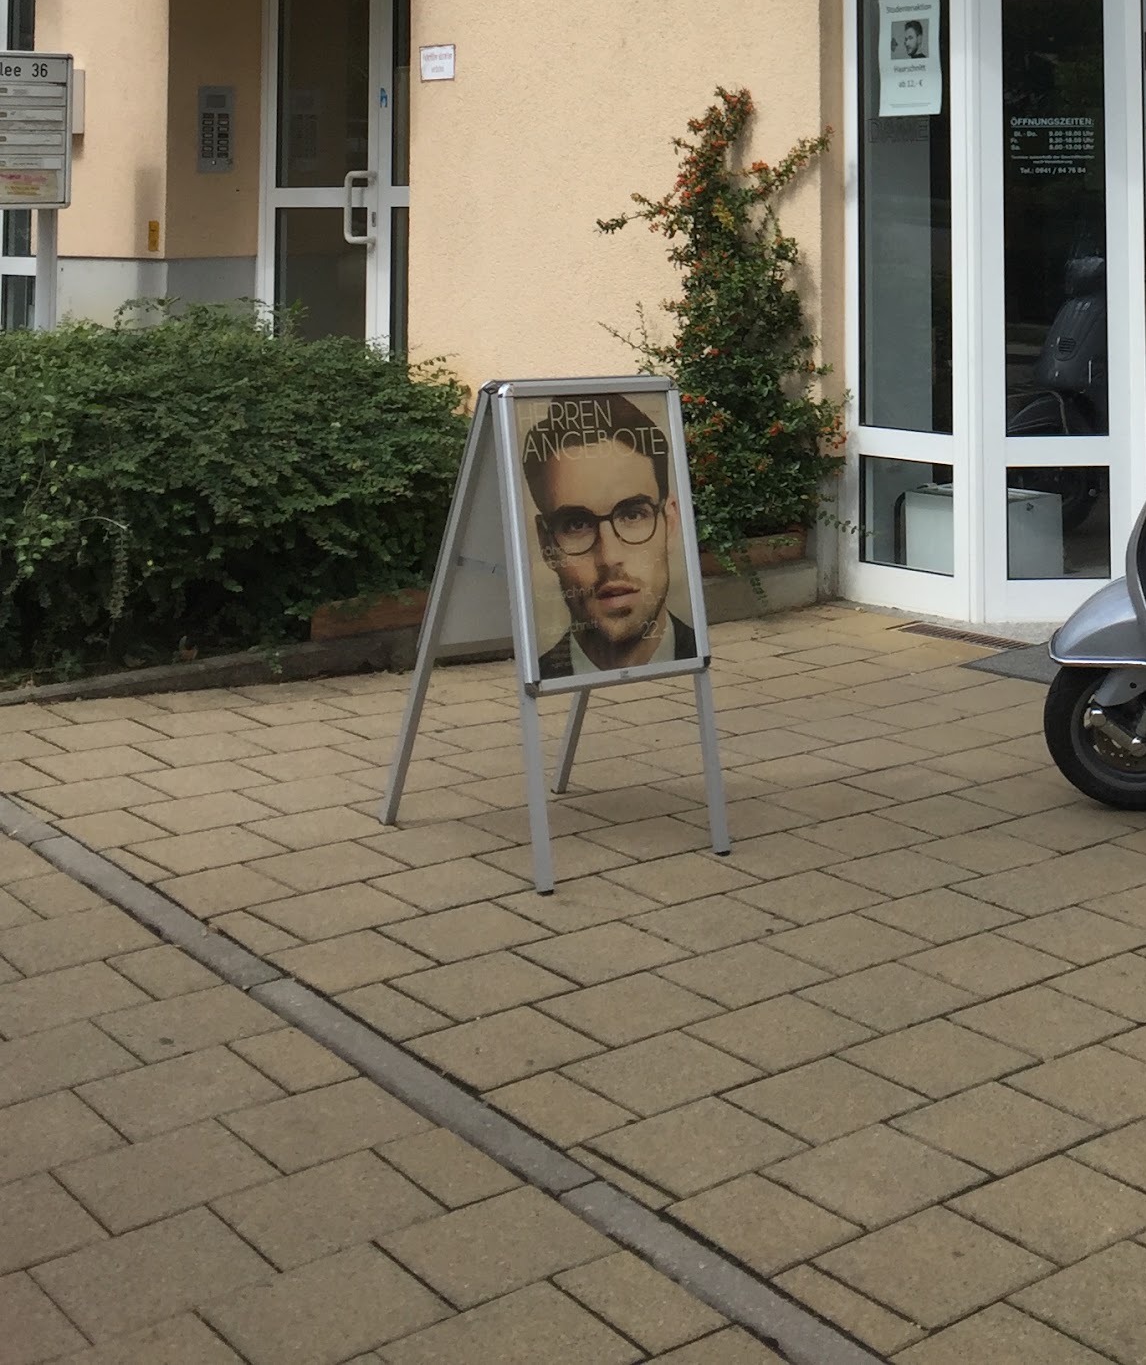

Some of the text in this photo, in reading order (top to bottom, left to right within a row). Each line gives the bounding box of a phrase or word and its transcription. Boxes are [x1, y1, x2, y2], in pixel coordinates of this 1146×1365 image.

[31, 63, 49, 78] 36
[1010, 116, 1095, 126] ÖFFNUNGSZEITEN:
[517, 399, 613, 433] HERREN
